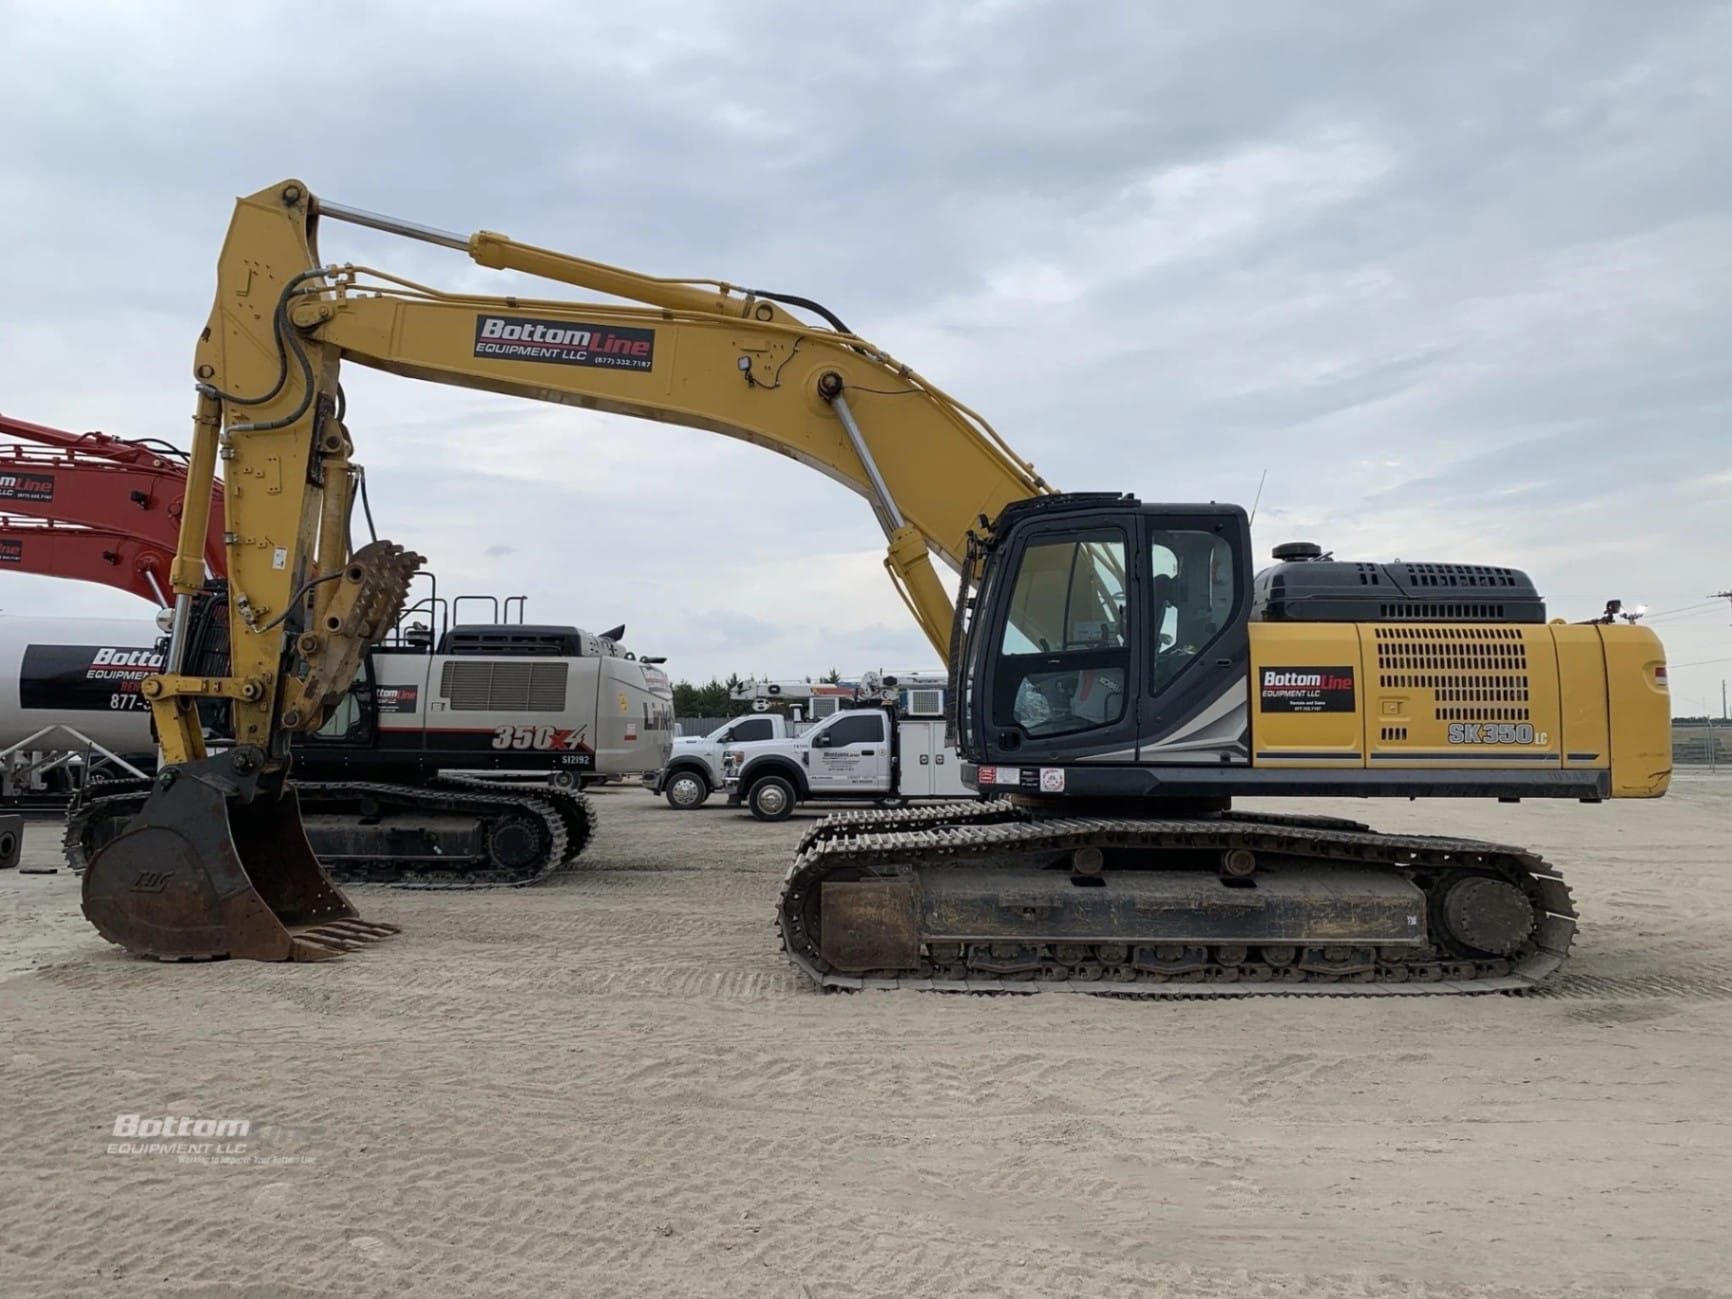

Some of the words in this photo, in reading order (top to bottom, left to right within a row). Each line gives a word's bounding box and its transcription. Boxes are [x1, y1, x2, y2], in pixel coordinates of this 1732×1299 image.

[476, 343, 561, 359] EQUIPMENT
[562, 350, 587, 360] LLC
[1262, 690, 1306, 698] EQUIPMENT
[1448, 723, 1534, 744] SK350
[1535, 733, 1548, 744] LC
